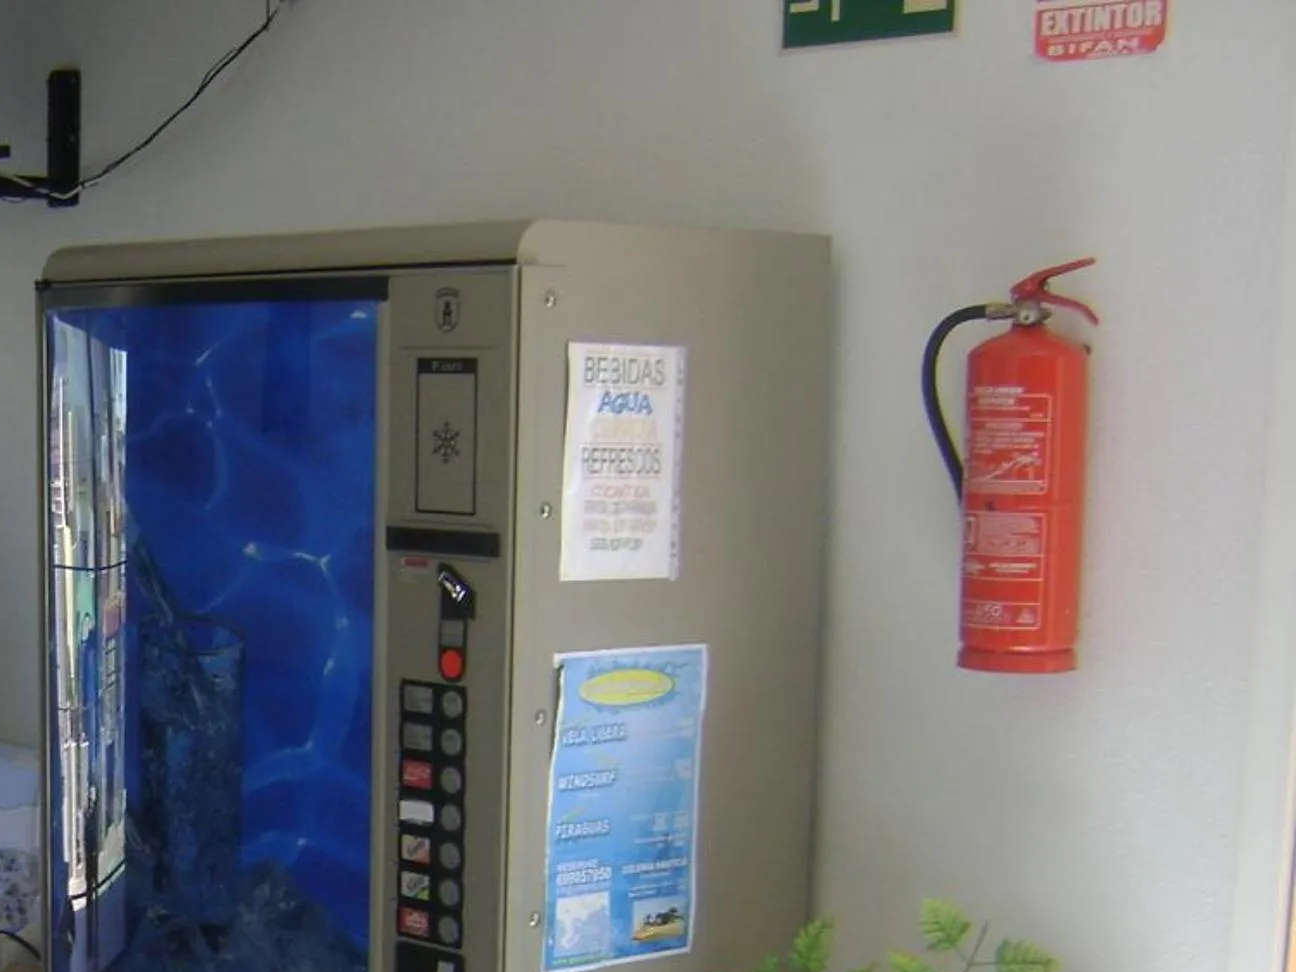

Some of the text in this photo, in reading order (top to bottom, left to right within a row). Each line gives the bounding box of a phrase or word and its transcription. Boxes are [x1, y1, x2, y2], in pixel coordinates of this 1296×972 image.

[1040, 1, 1162, 36] EXTINTOR
[584, 356, 666, 386] BEBIDAS
[597, 390, 653, 415] AGUA
[581, 446, 661, 475] REFRESCOS
[558, 770, 616, 791] WINDSURF
[555, 818, 611, 840] PIRAGUAS
